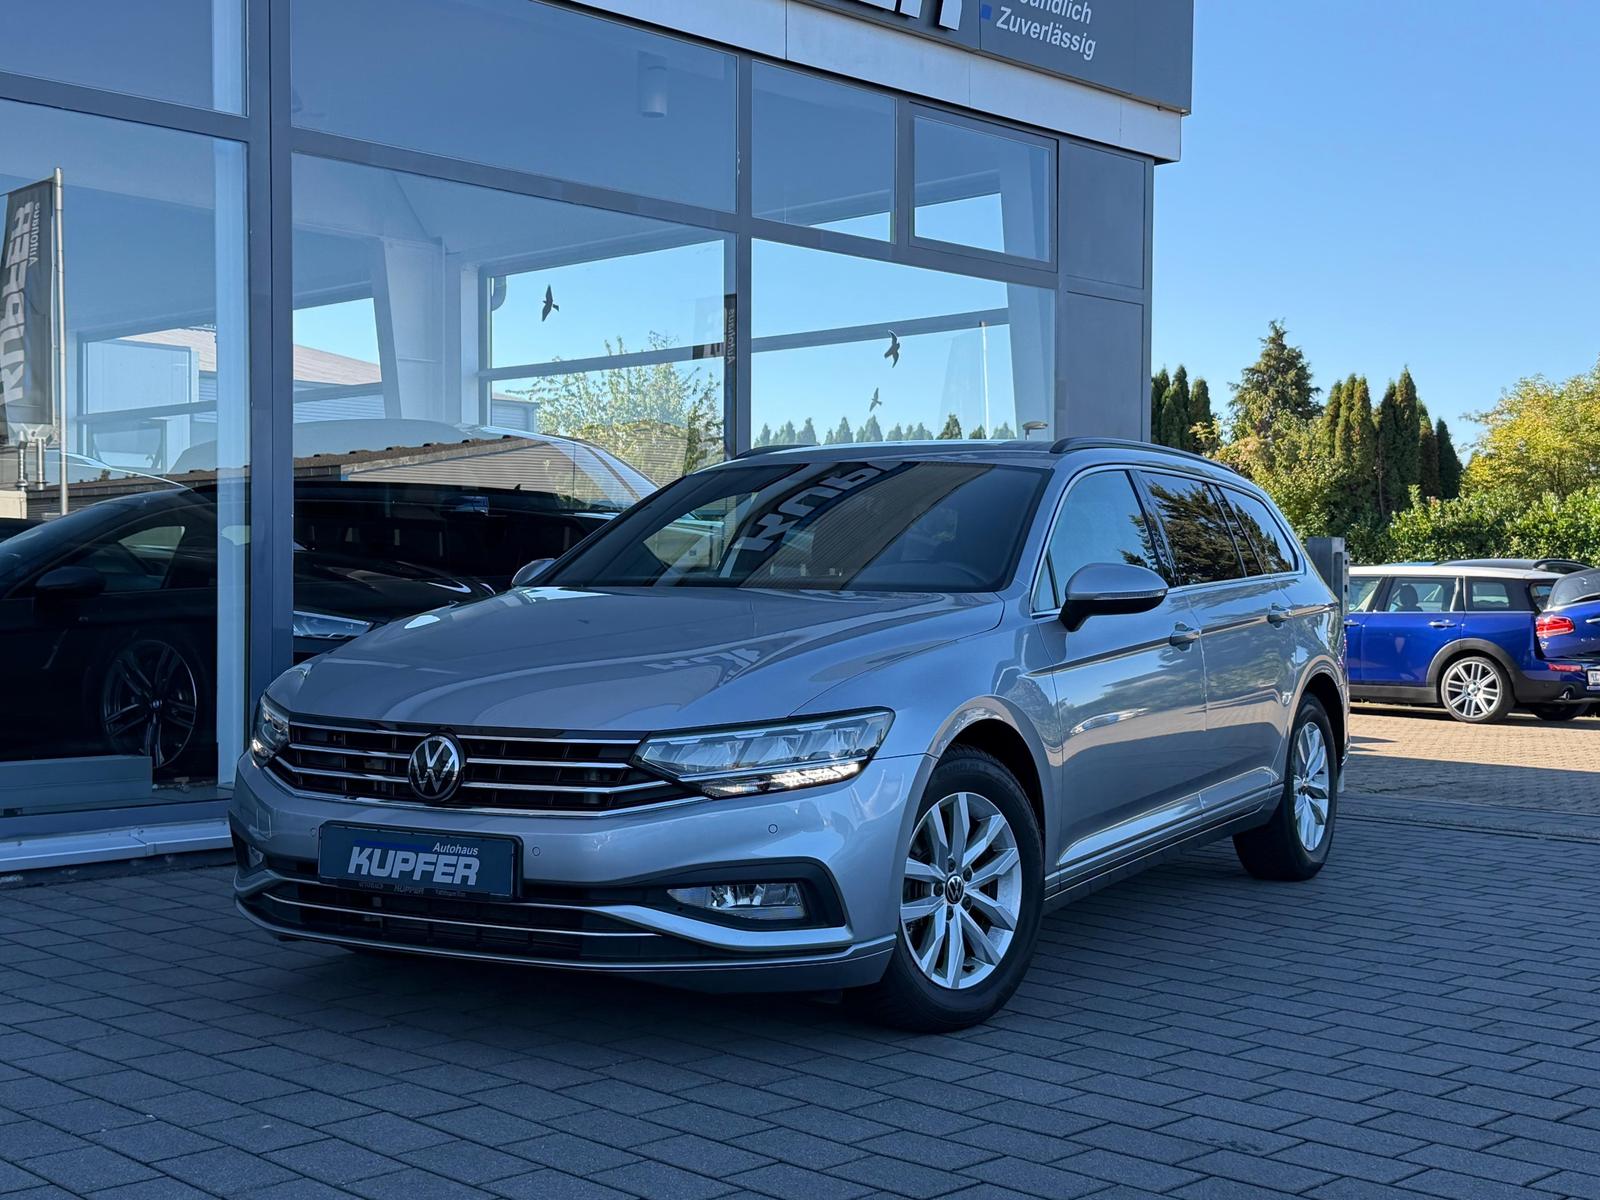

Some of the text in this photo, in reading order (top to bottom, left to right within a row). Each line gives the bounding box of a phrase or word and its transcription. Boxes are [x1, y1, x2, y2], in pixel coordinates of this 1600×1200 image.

[996, 6, 1096, 60] Zuverlässig
[347, 846, 480, 886] KUPFER
[432, 842, 479, 856] Autohaus
